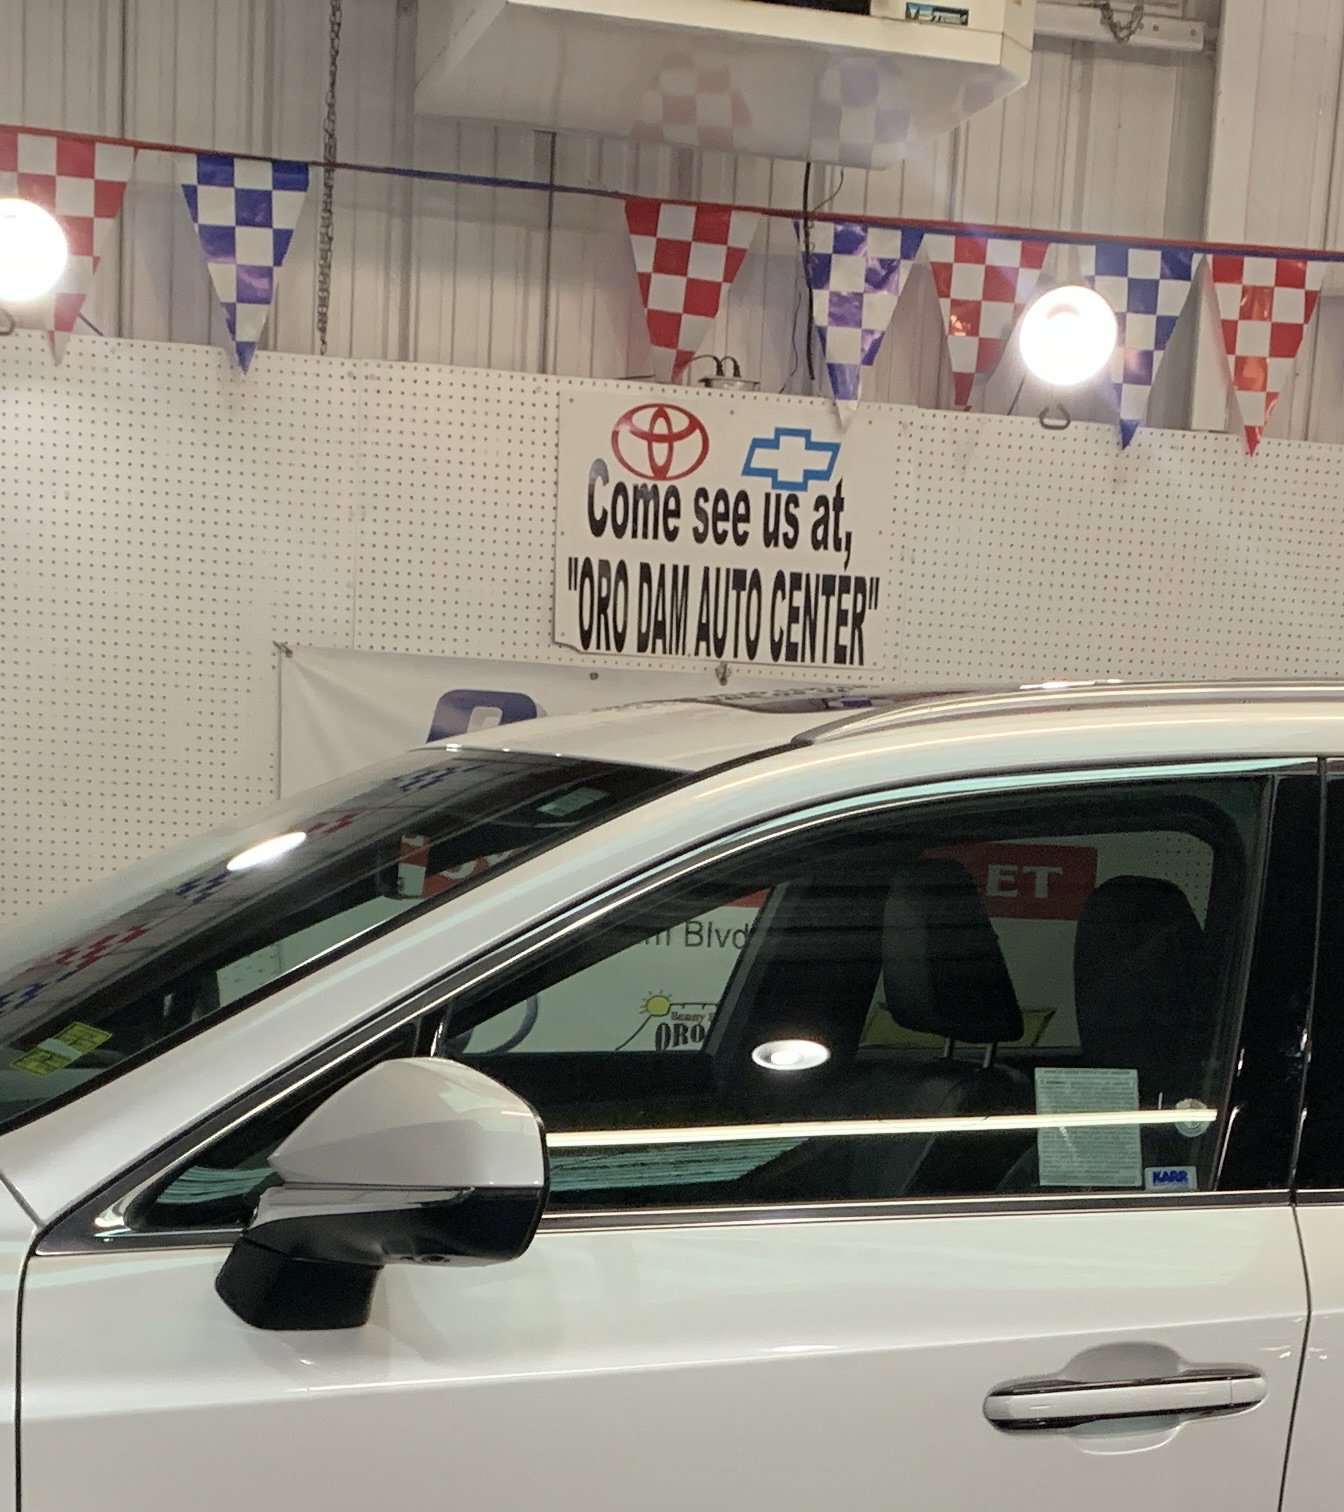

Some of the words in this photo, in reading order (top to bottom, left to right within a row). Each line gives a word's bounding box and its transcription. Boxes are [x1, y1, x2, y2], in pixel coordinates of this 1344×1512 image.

[588, 458, 681, 542] Come
[692, 487, 751, 546] see
[763, 492, 800, 550] us
[811, 477, 853, 571] at,
[568, 557, 629, 653] "ORO
[637, 562, 690, 656] DAM
[694, 566, 763, 661] AUTO
[769, 570, 881, 666] CENTER"
